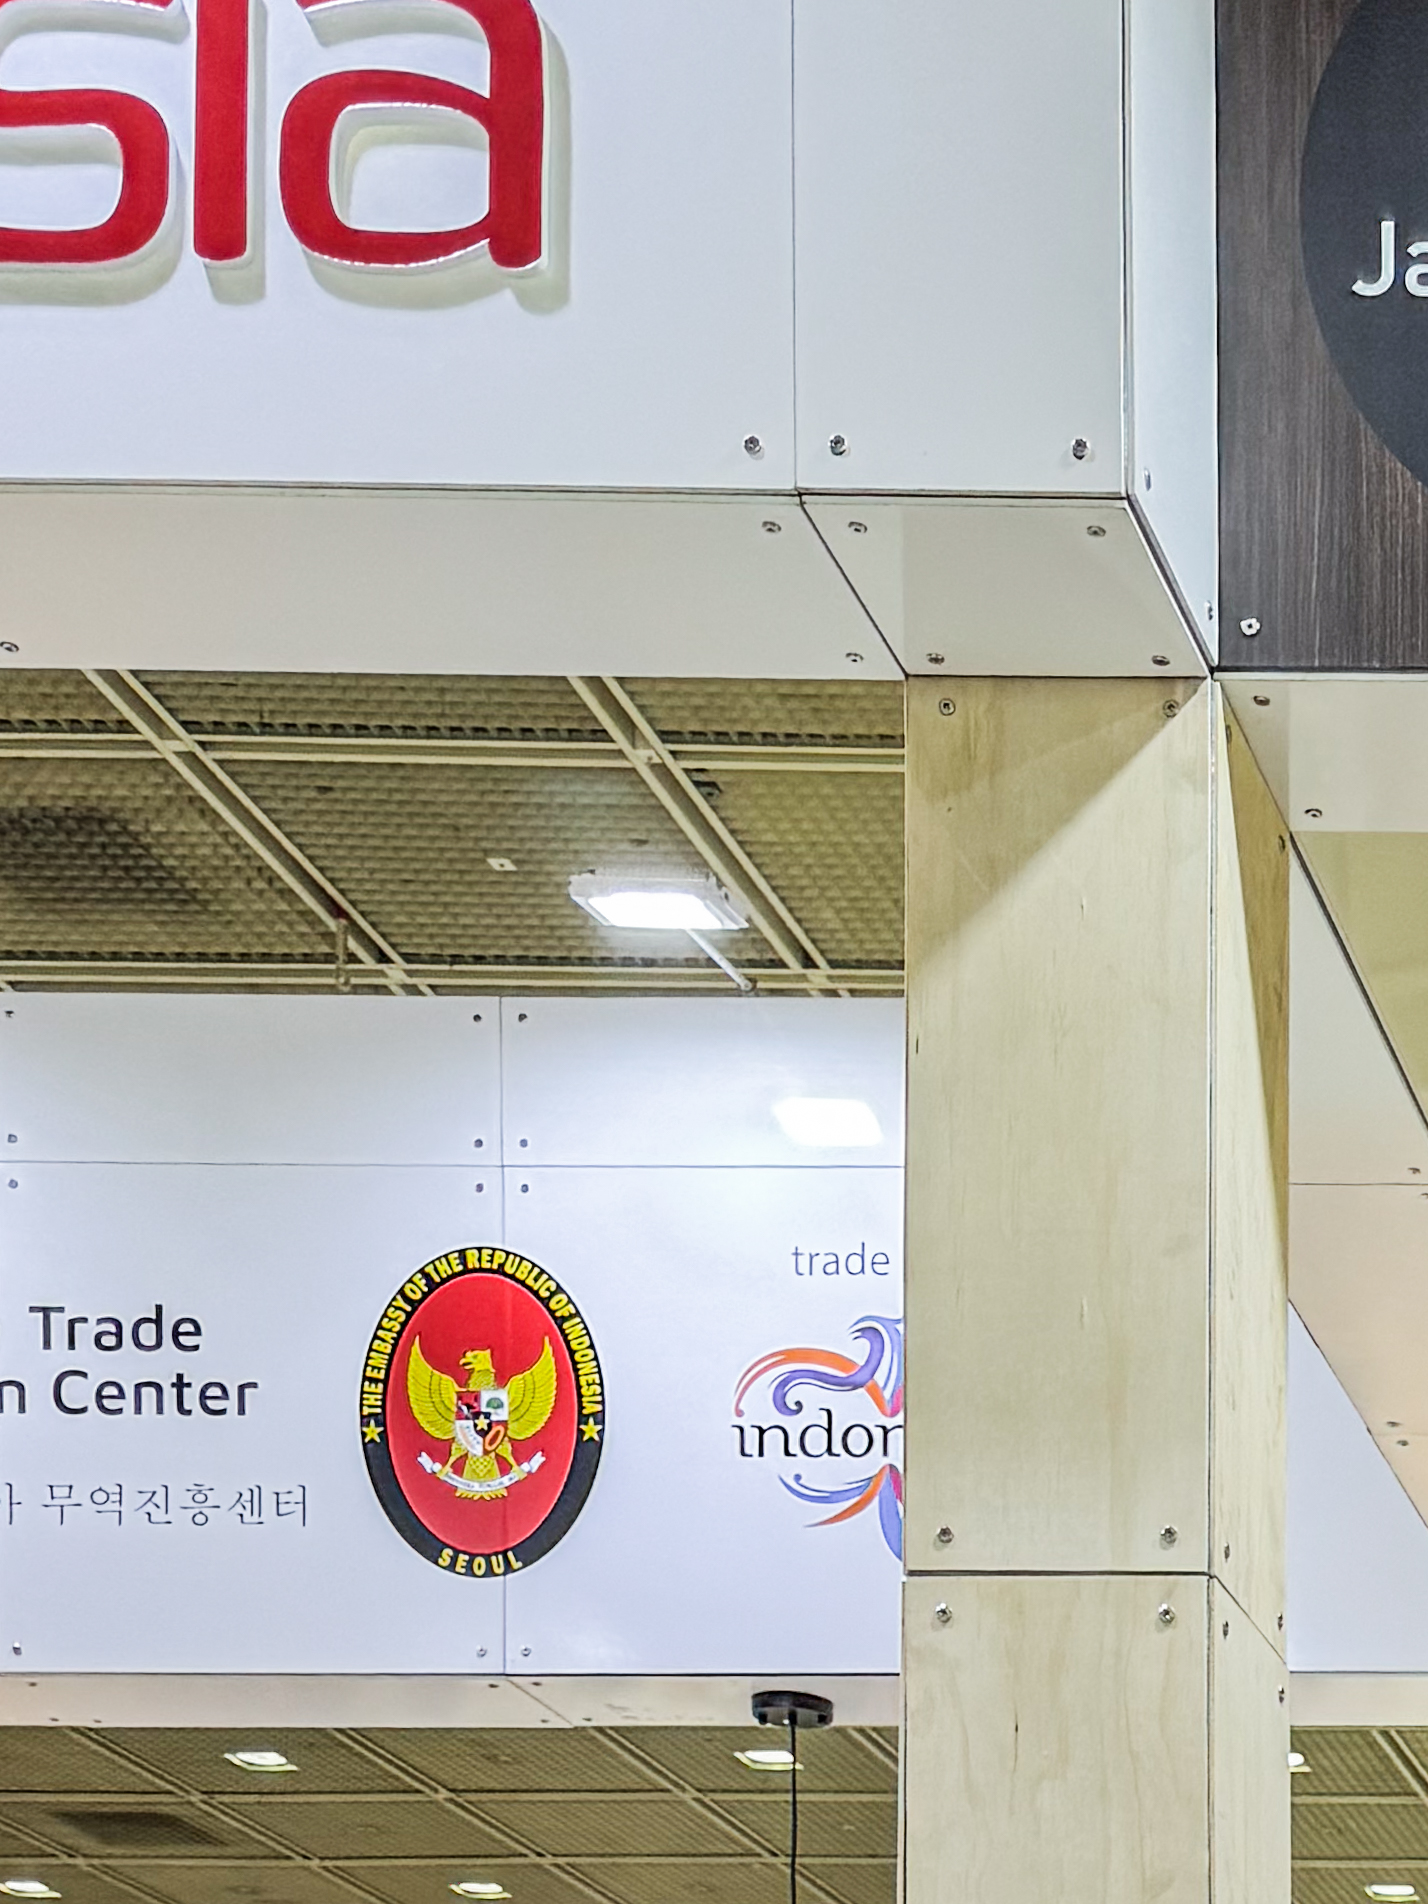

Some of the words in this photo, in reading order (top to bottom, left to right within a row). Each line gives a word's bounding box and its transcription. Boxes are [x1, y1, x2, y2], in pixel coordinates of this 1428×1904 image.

[425, 1252, 464, 1283] THE
[465, 1248, 559, 1298] REPUBLIC
[791, 1240, 890, 1276] trade
[404, 1275, 429, 1300] OF
[548, 1293, 574, 1319] OF
[28, 1303, 203, 1352] Trade
[364, 1291, 413, 1387] EMBASSY
[562, 1318, 604, 1416] INDONESIA
[52, 1369, 259, 1416] Center
[362, 1389, 384, 1416] THE
[41, 1481, 307, 1527] 무역진흥센터
[437, 1548, 523, 1577] SEOUL
